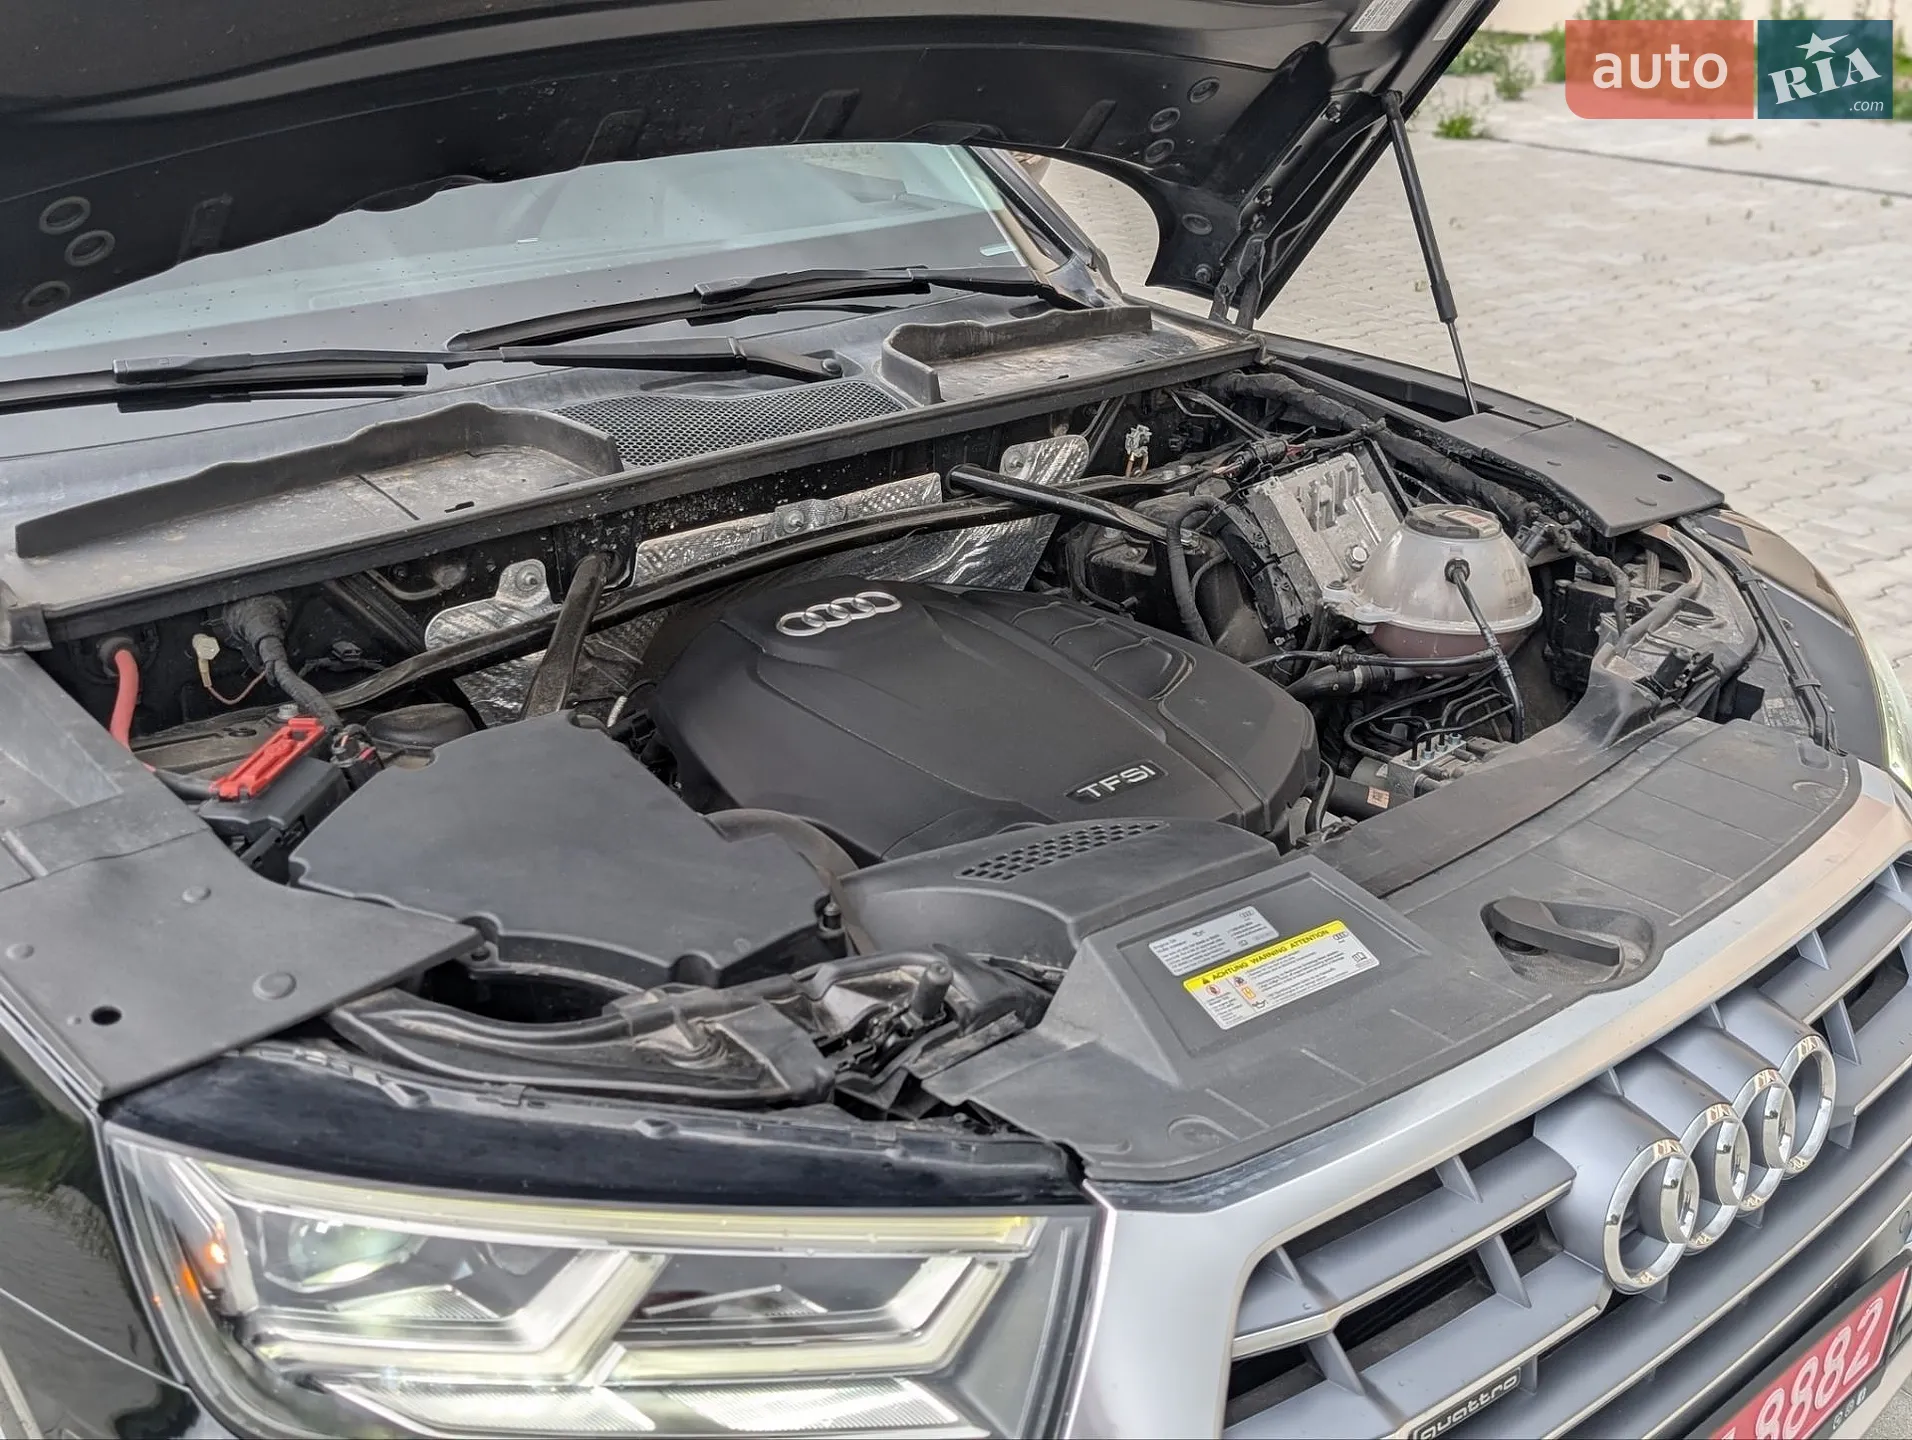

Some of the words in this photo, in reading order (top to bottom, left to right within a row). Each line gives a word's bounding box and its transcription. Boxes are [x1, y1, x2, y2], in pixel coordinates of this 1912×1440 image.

[1076, 764, 1157, 798] TFSI
[1212, 961, 1248, 981] ACHTUNG
[1250, 946, 1288, 966] WARNING
[1290, 929, 1330, 949] ATTENTION
[1420, 1375, 1517, 1440] quattro
